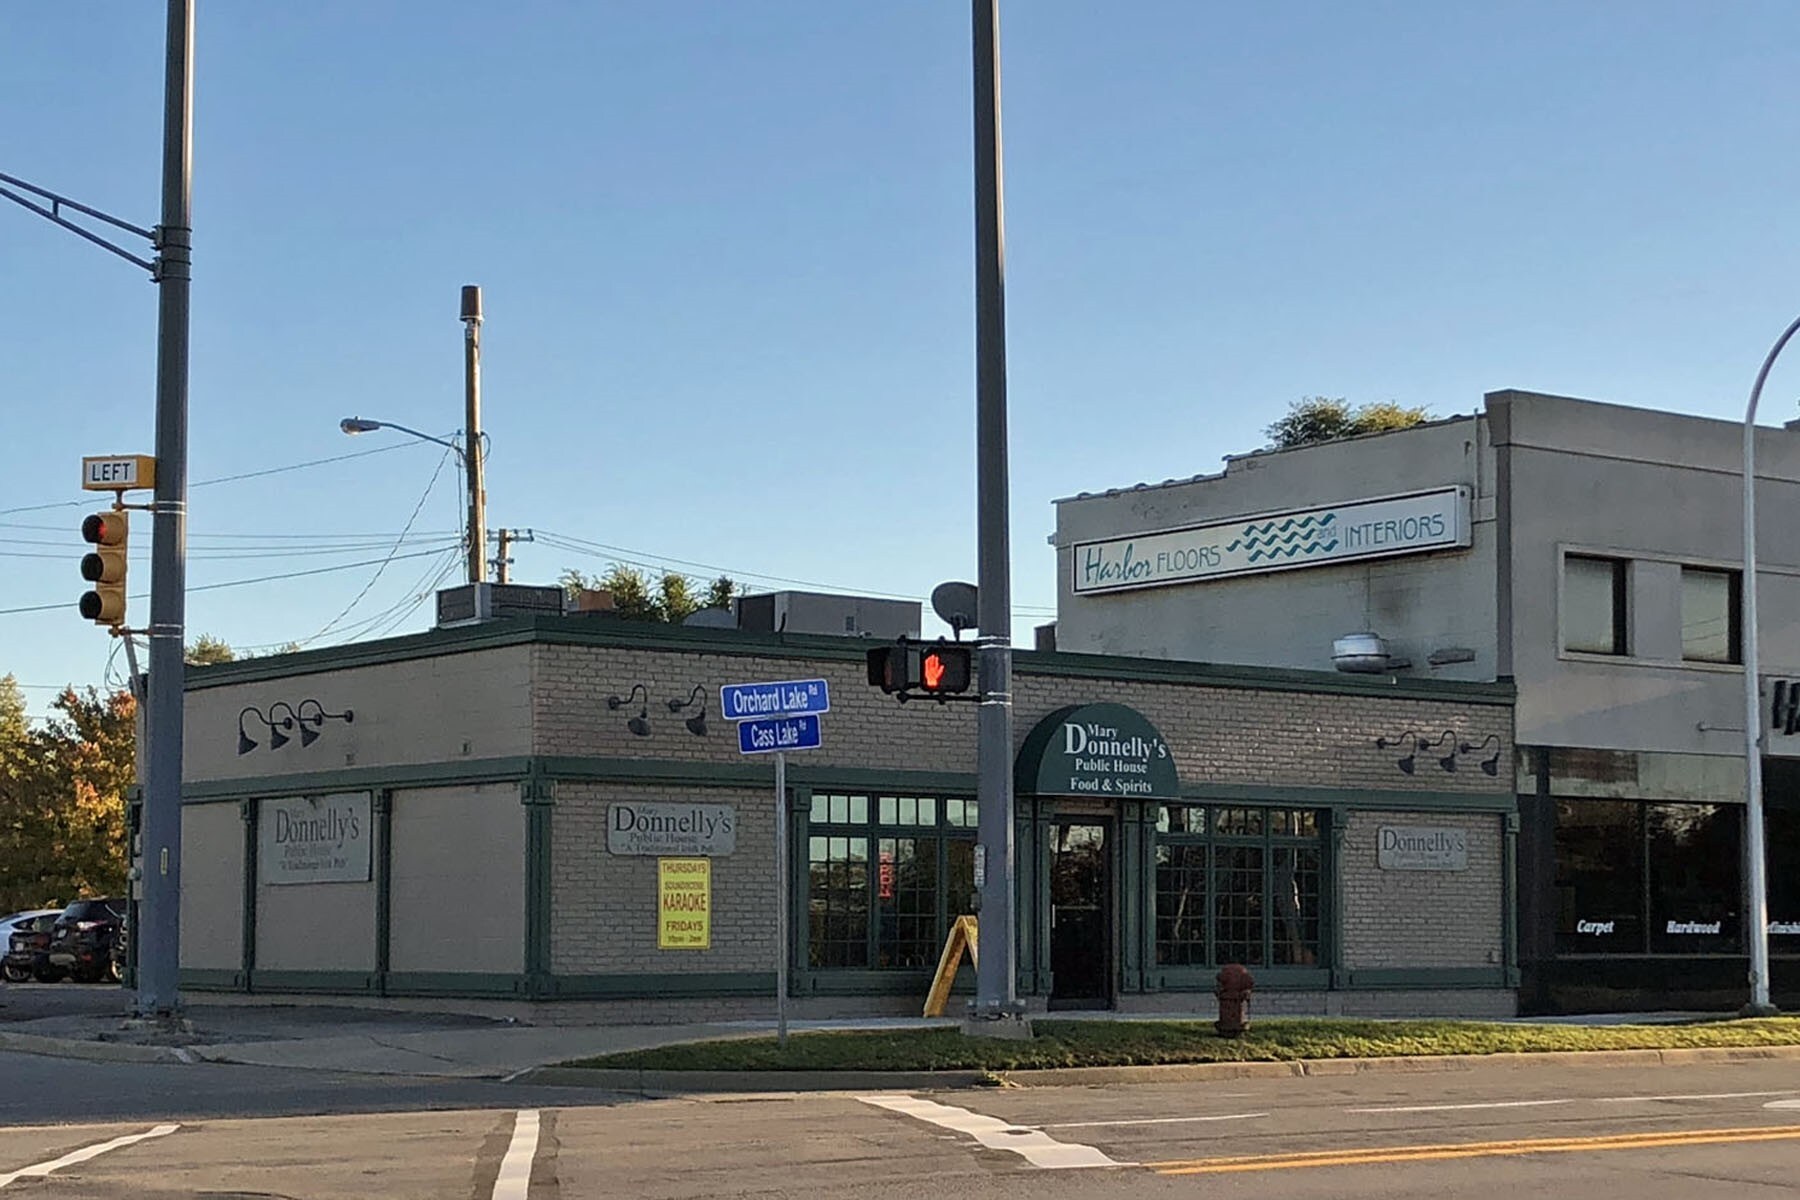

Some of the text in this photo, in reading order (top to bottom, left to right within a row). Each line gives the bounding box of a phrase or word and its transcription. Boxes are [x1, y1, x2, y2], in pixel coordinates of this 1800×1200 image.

[92, 463, 131, 481] LEFT
[1085, 543, 1152, 585] Harbor
[1157, 545, 1221, 573] FLOORS
[1345, 513, 1445, 548] INTERIORS
[733, 684, 818, 713] Orchard Lake Rd
[751, 724, 775, 747] Cass
[776, 721, 799, 745] Lake
[1087, 723, 1118, 740] Mary
[1064, 723, 1166, 762] Donnelly's
[1075, 758, 1148, 774] Public House
[1070, 777, 1152, 795] Food & Spirits
[276, 807, 360, 849] Donnelly's
[615, 806, 732, 839] Donnelly's
[1383, 830, 1465, 858] Donnelly's
[662, 862, 707, 874] THURSDAYS
[663, 893, 707, 912] KARAOKE
[666, 921, 704, 932] FRIDAYS
[1577, 920, 1615, 936] Carpet
[1666, 921, 1721, 934] Hardwood
